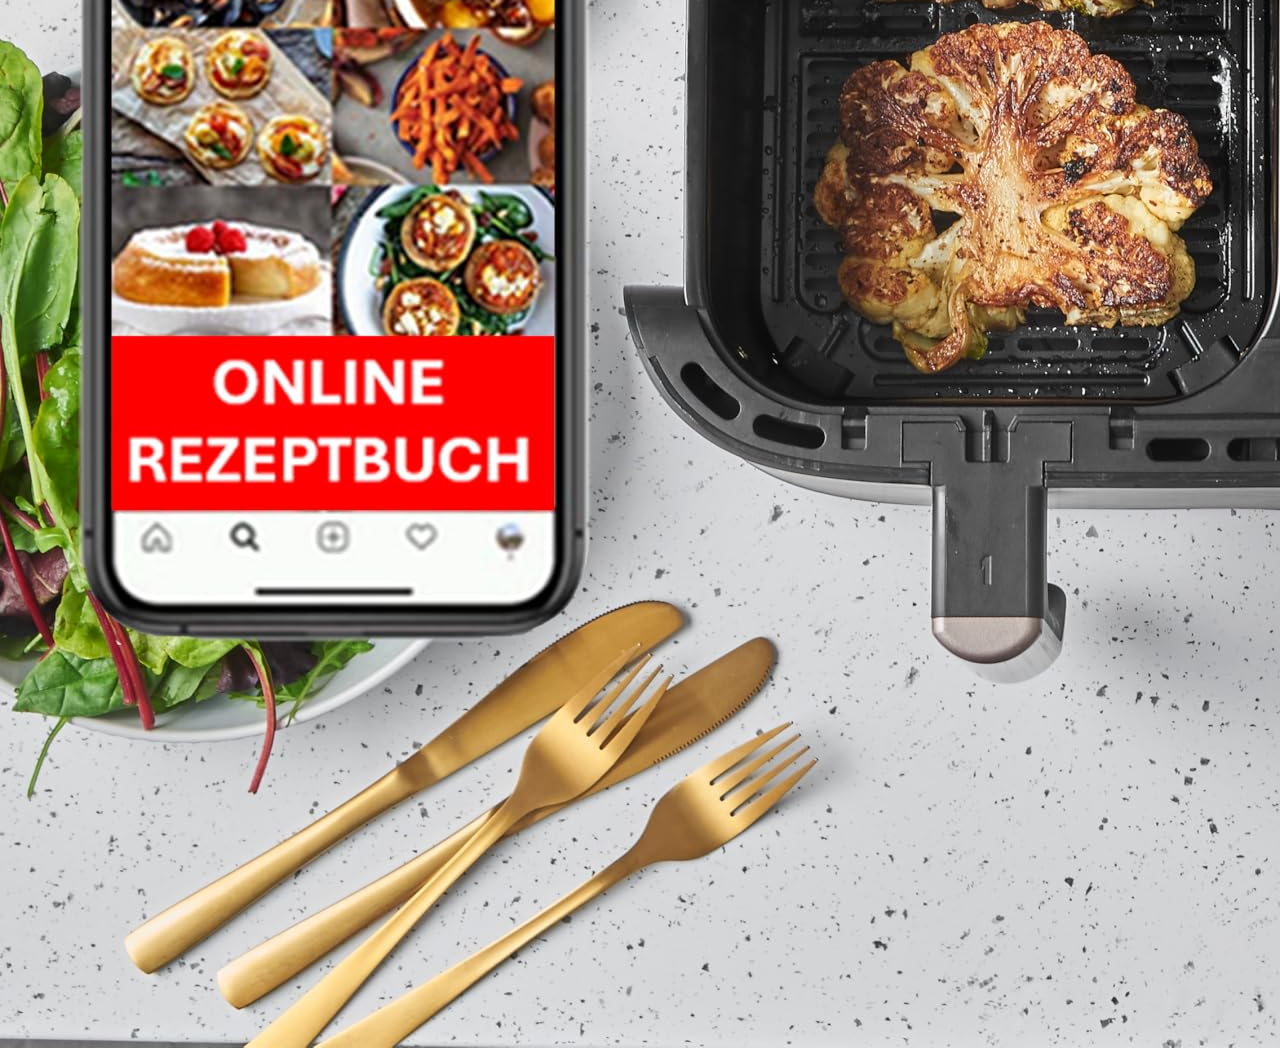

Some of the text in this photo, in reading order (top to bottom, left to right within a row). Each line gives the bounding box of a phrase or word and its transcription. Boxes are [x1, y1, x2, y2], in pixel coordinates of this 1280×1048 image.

[214, 360, 443, 404] ONLINE
[130, 437, 528, 482] REZEPTBUCH
[980, 554, 993, 586] 1
